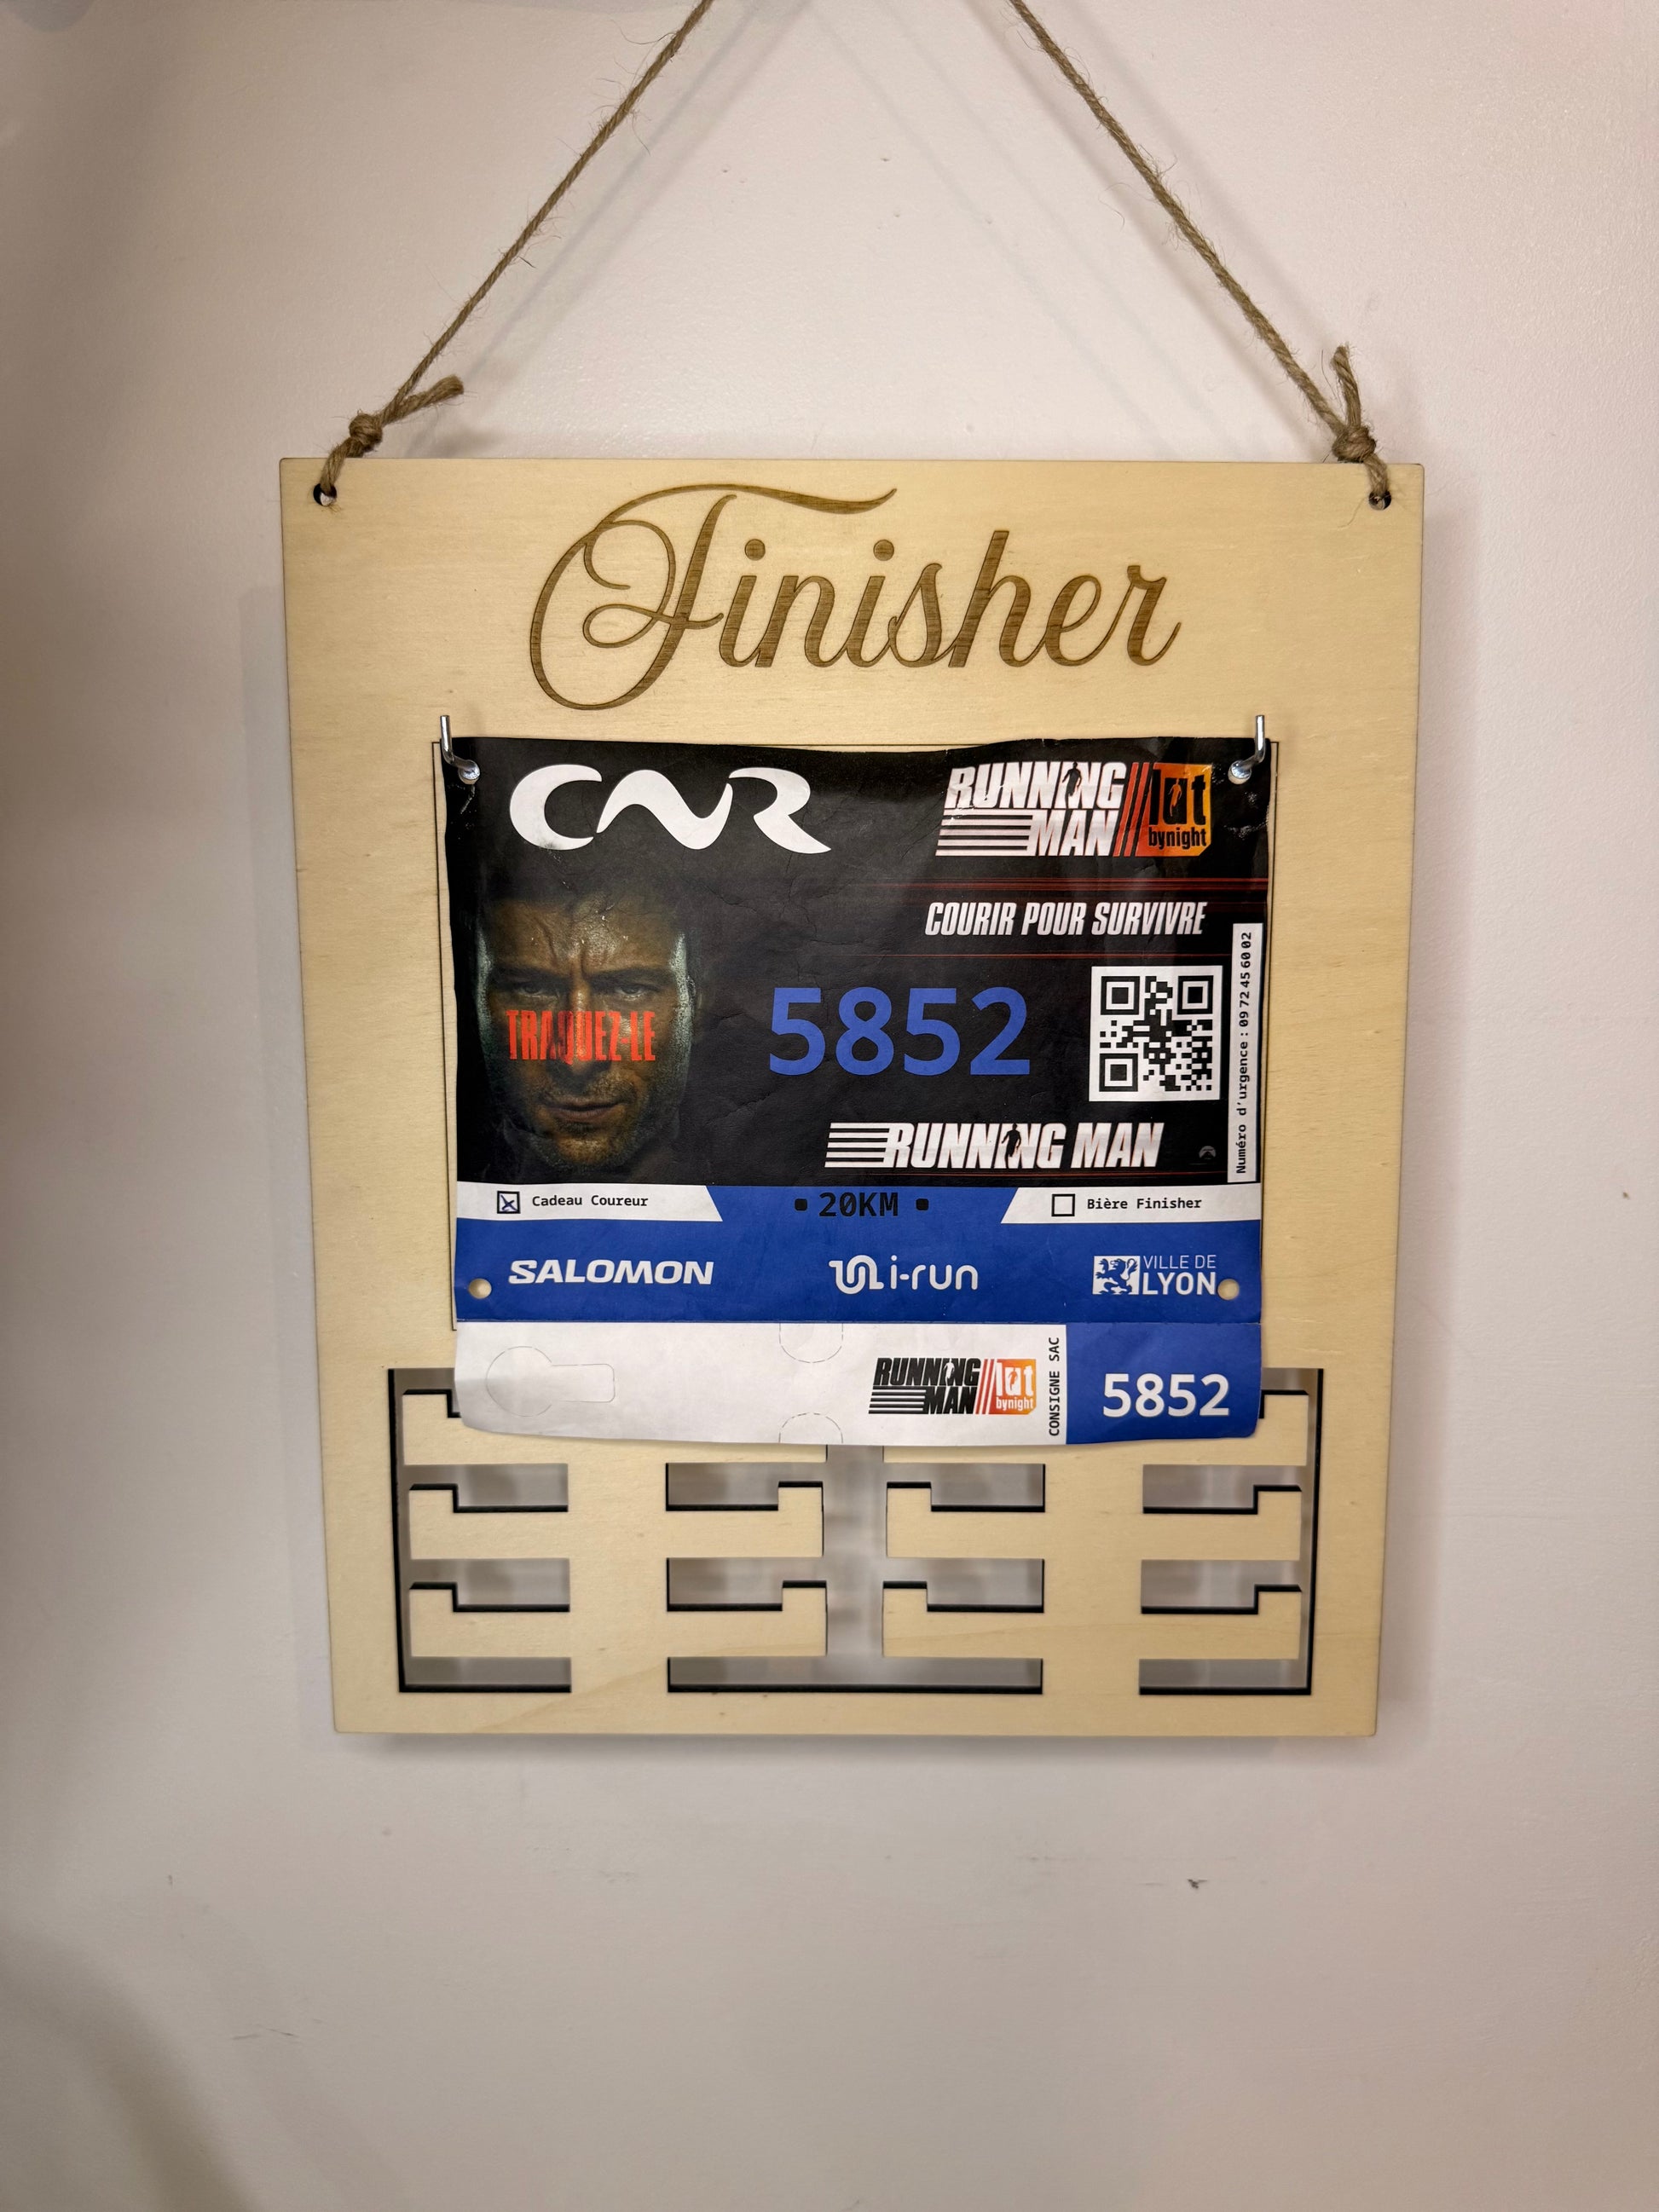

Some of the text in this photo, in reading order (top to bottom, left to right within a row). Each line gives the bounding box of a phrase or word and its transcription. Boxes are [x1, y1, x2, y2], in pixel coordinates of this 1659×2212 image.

[529, 482, 1182, 711] Finisher
[944, 760, 1130, 810] RUNNING
[509, 763, 831, 855] CNR
[1026, 808, 1121, 858] MAN
[1147, 827, 1208, 850] bynight
[924, 901, 1208, 937] COURIR POUR SURVIVRE
[506, 1009, 656, 1066] TRAQUEZ-LE
[769, 985, 1031, 1077] 5852
[1236, 1040, 1251, 1117] d'urgence
[882, 1122, 1165, 1170] RUNNING MAN
[1235, 1123, 1247, 1175] Numéro
[531, 1194, 649, 1207] Cadeau Coureur
[818, 1190, 899, 1218] 20KM
[1086, 1197, 1203, 1210] Bière Finisher
[507, 1258, 714, 1286] SALOMON
[890, 1255, 979, 1291] i-run
[1143, 1255, 1217, 1269] VILLE DE
[1142, 1272, 1217, 1296] LYON
[874, 1357, 980, 1388] RUNNING
[1048, 1336, 1061, 1438] CONSIGNE SAC
[923, 1387, 977, 1415] MAN
[995, 1397, 1034, 1413] bynight
[1102, 1372, 1230, 1418] 5852
